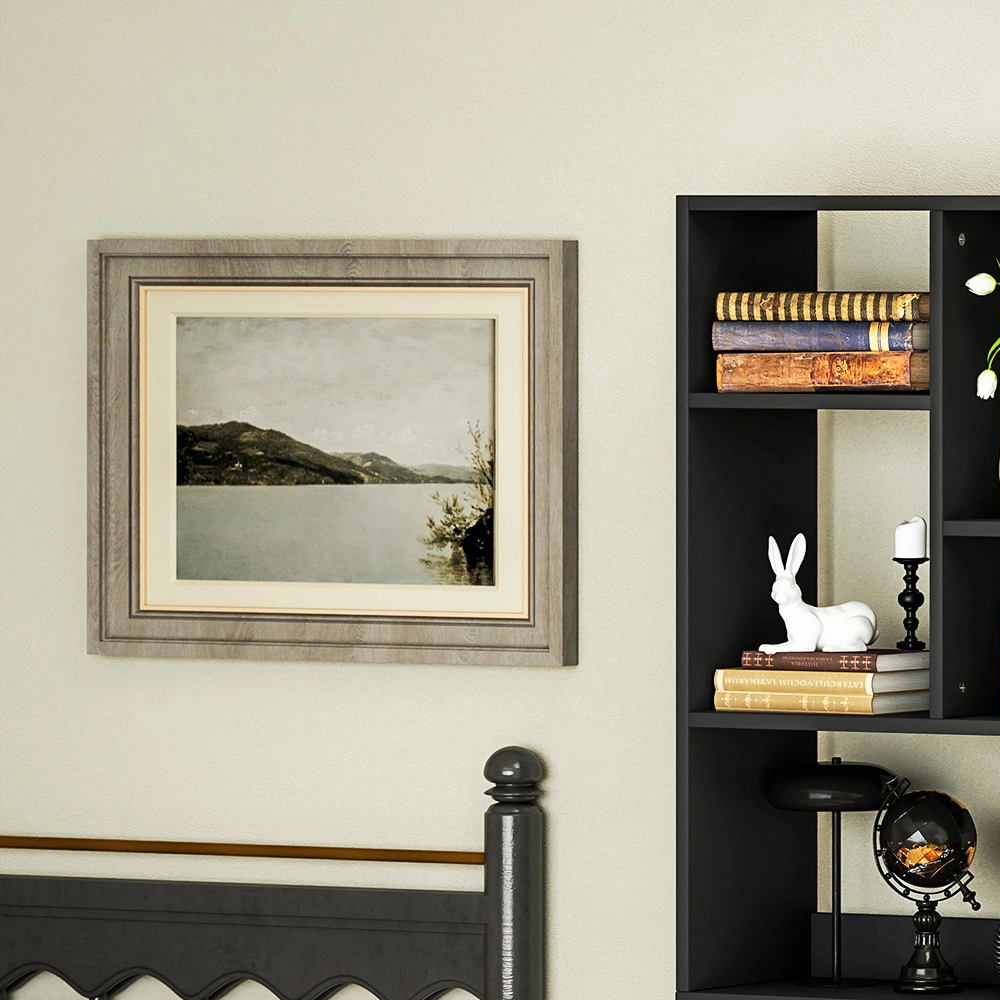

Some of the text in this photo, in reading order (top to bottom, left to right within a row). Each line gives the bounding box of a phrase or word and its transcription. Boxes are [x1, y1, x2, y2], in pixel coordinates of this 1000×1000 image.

[724, 676, 864, 689] LATERCULI VOCUM LATINARUM
